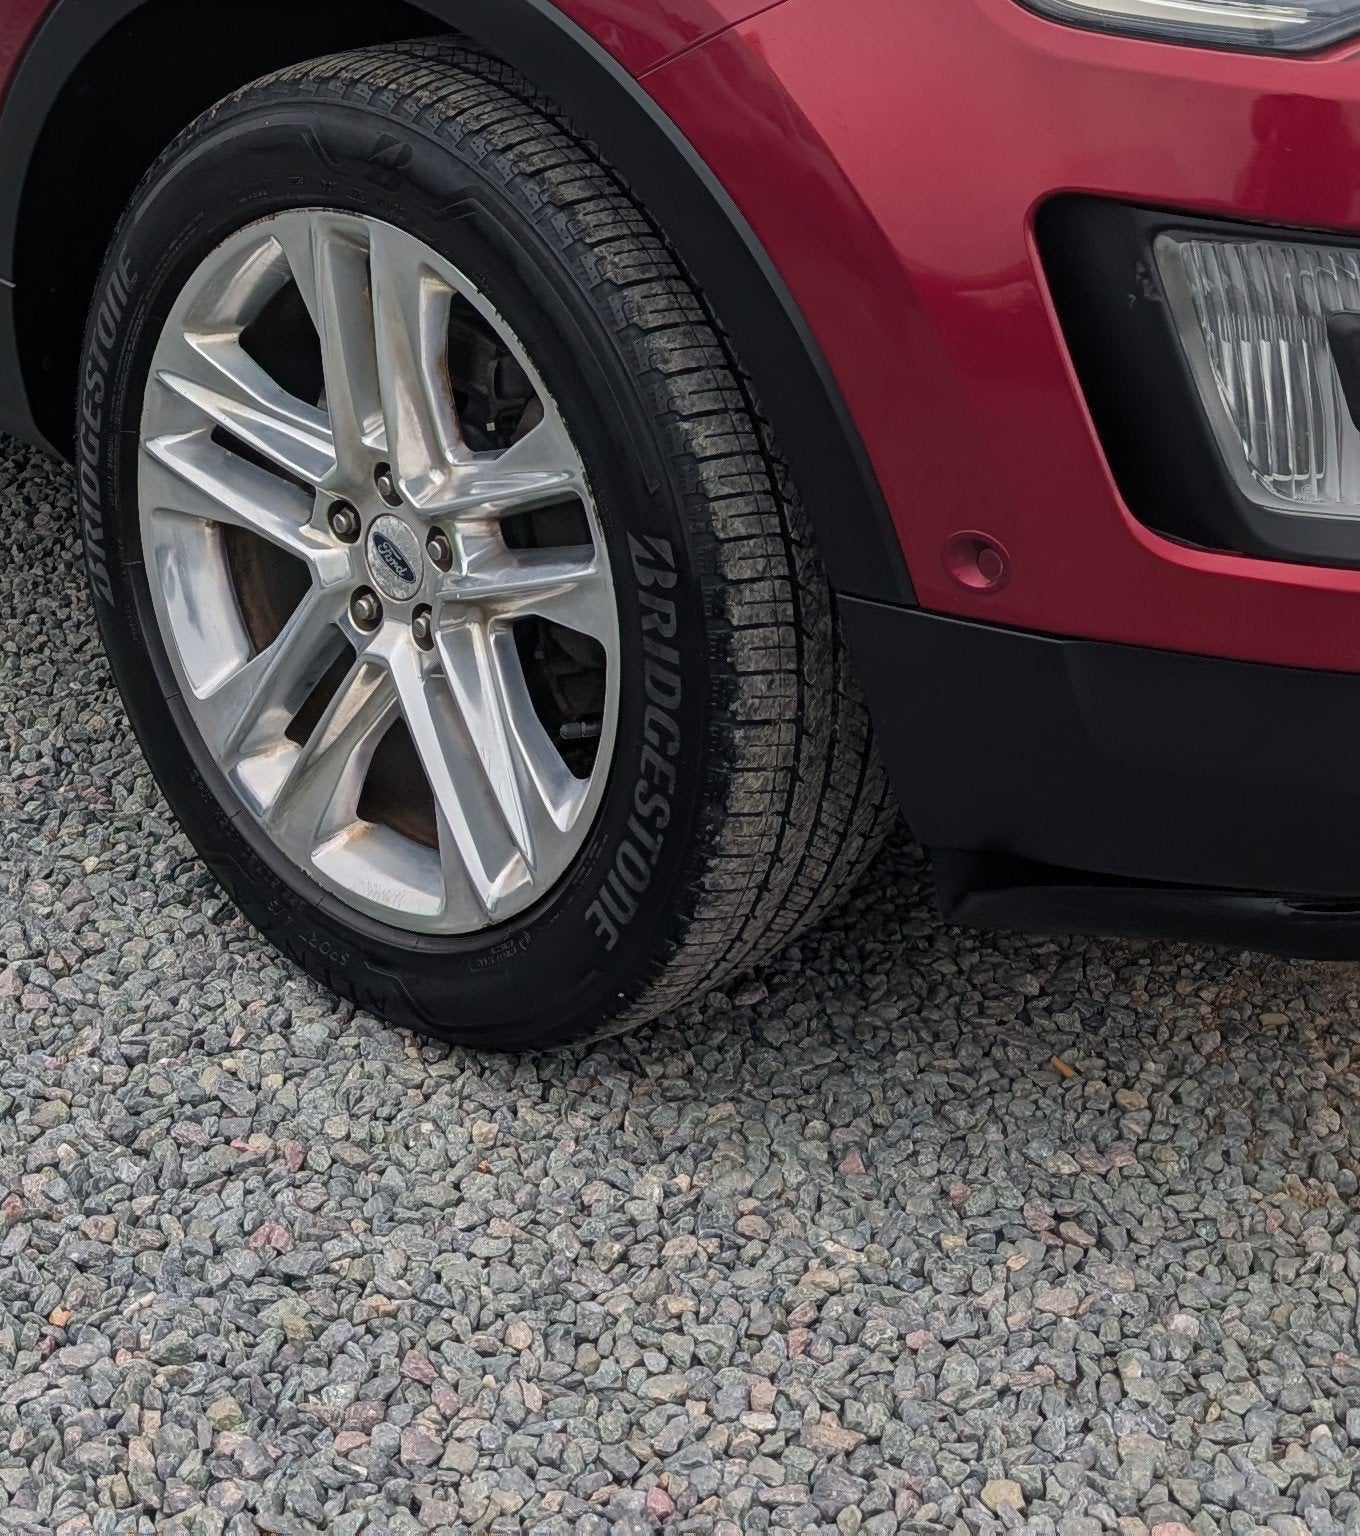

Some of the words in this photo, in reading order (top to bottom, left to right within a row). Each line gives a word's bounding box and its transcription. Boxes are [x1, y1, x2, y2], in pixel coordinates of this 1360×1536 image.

[79, 242, 140, 610] BRIDGESTONE
[378, 541, 408, 576] Ford
[584, 530, 683, 952] BRIDGESTONE
